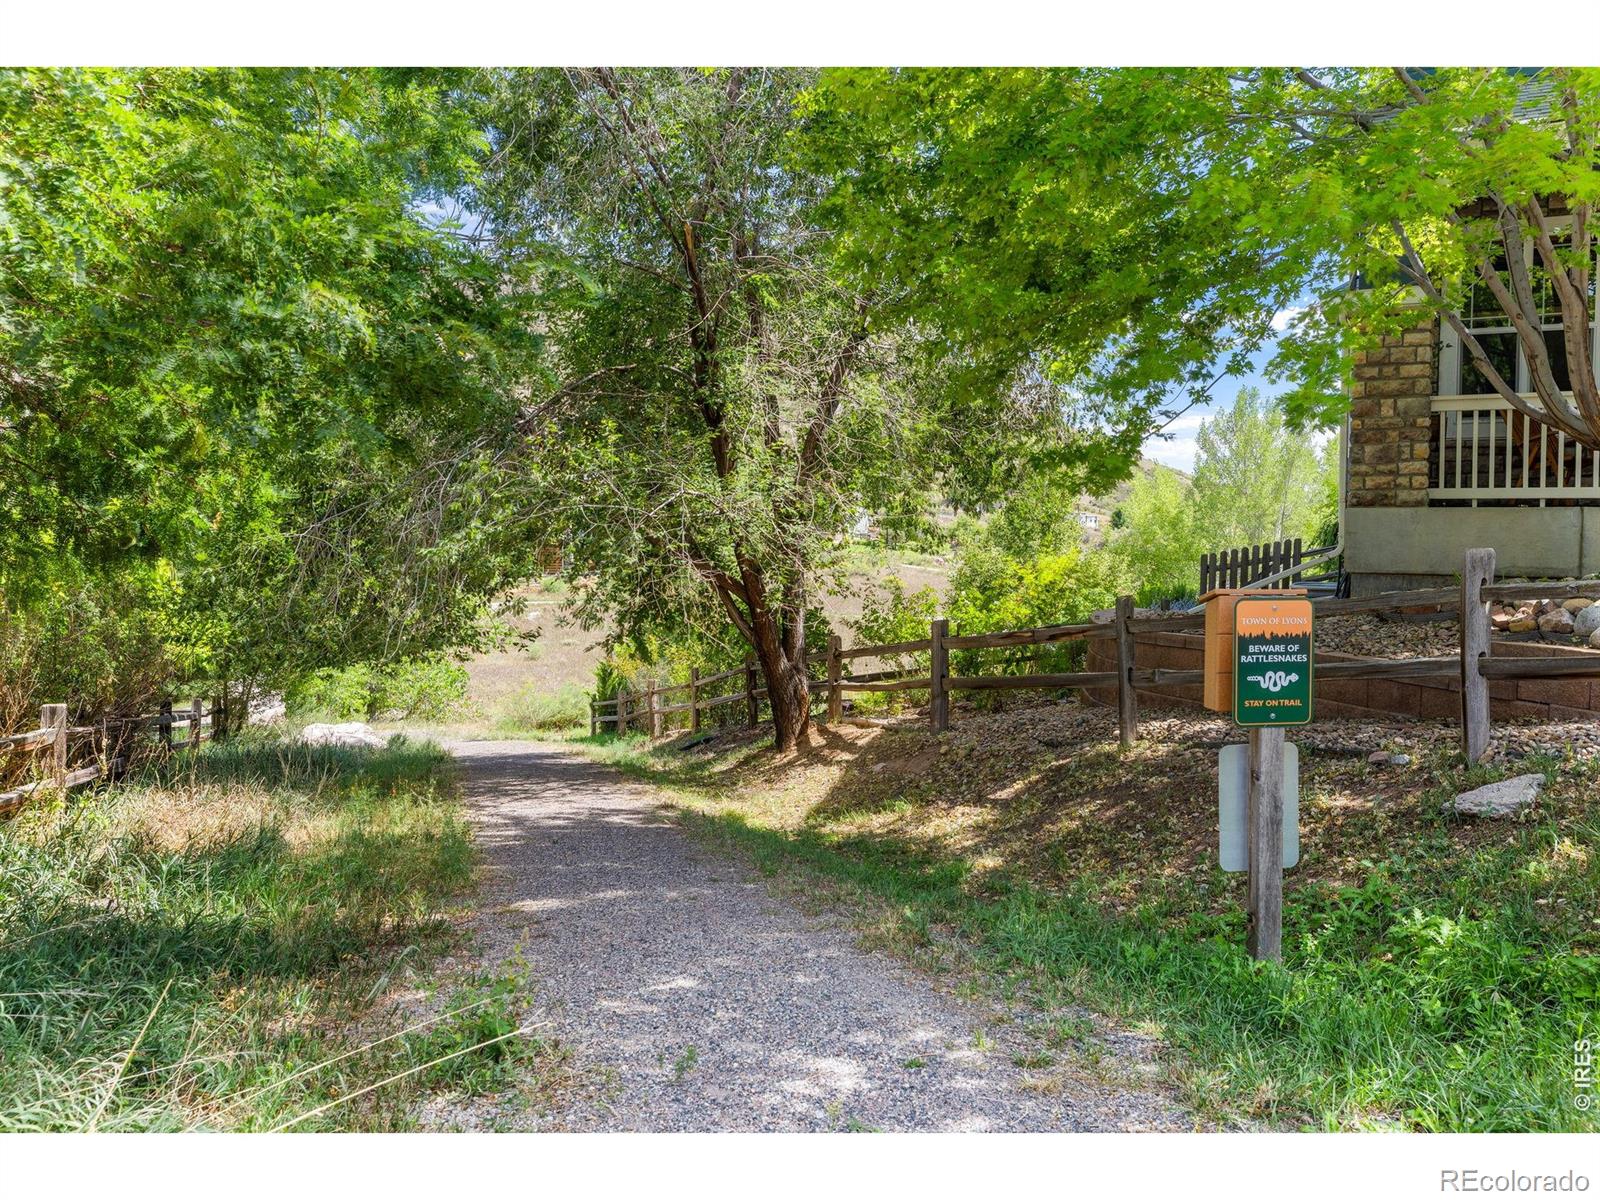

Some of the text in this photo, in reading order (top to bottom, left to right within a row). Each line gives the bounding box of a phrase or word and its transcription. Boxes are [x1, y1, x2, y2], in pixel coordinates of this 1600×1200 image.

[1242, 617, 1308, 625] TOWN OF LYONS
[1248, 644, 1300, 653] BEWARE OF
[1240, 654, 1308, 663] RATTLESNAKES
